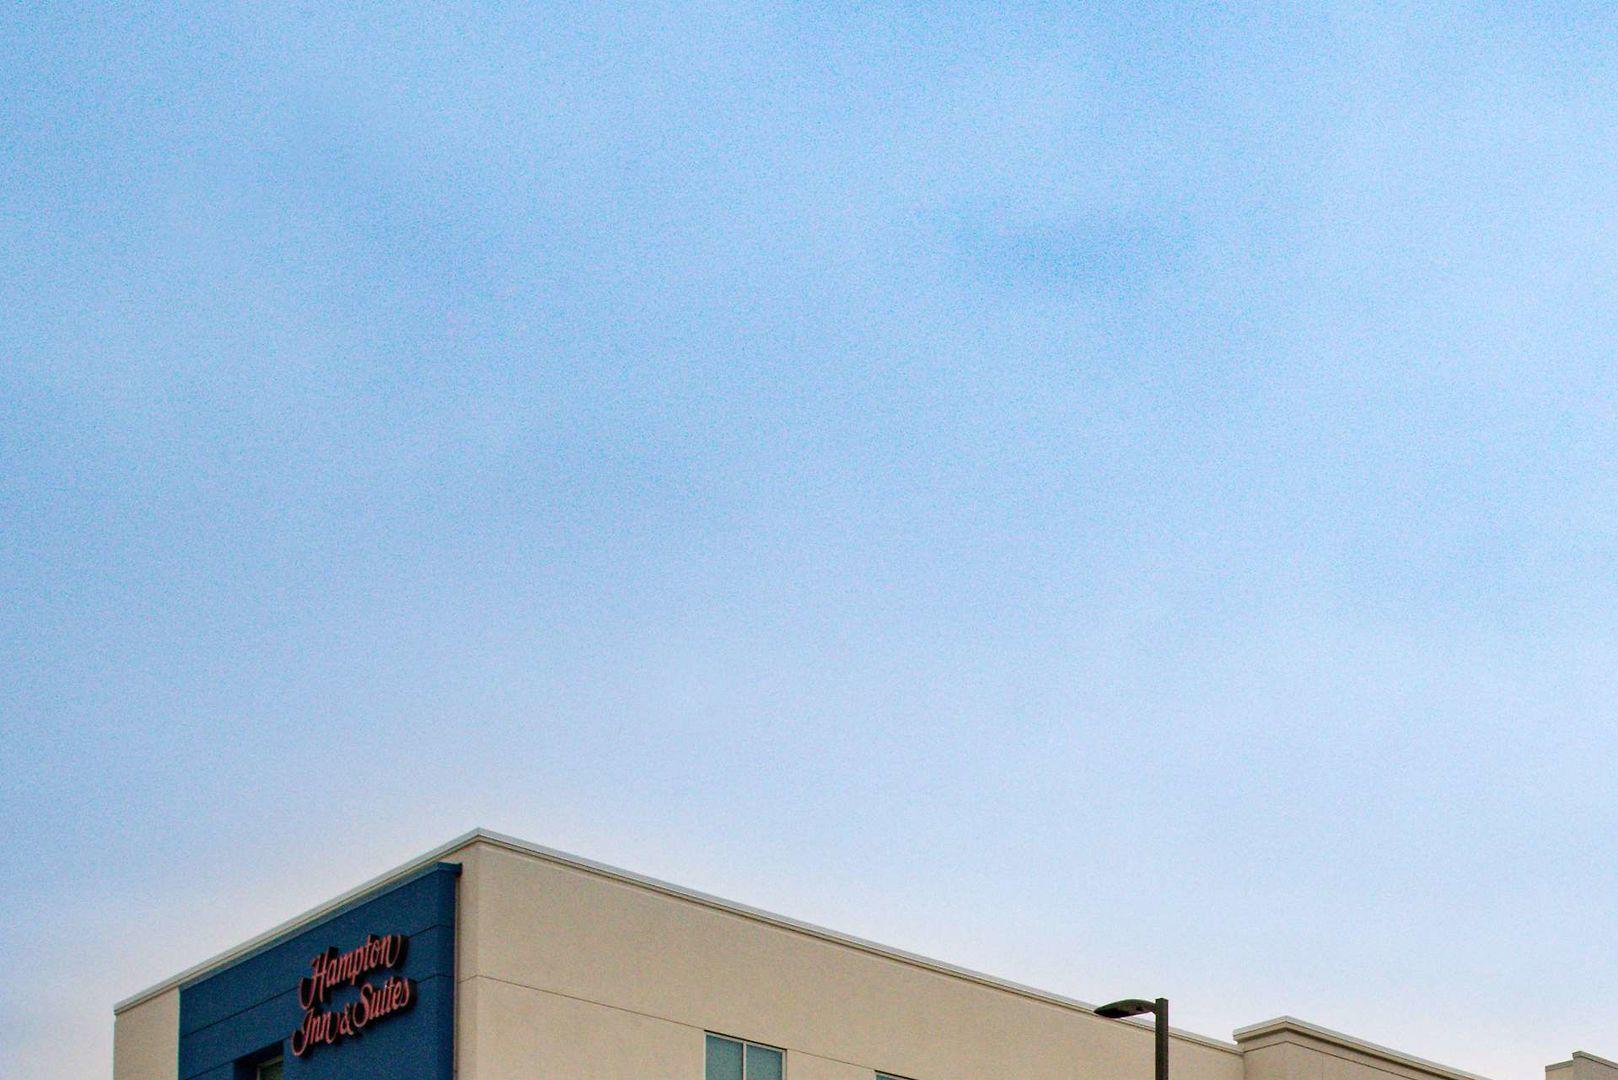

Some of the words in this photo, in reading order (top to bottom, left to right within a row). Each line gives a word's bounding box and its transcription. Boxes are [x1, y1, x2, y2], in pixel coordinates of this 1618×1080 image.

[299, 933, 402, 1010] Hampton
[291, 1007, 341, 1056] Inn
[352, 976, 410, 1028] Suites
